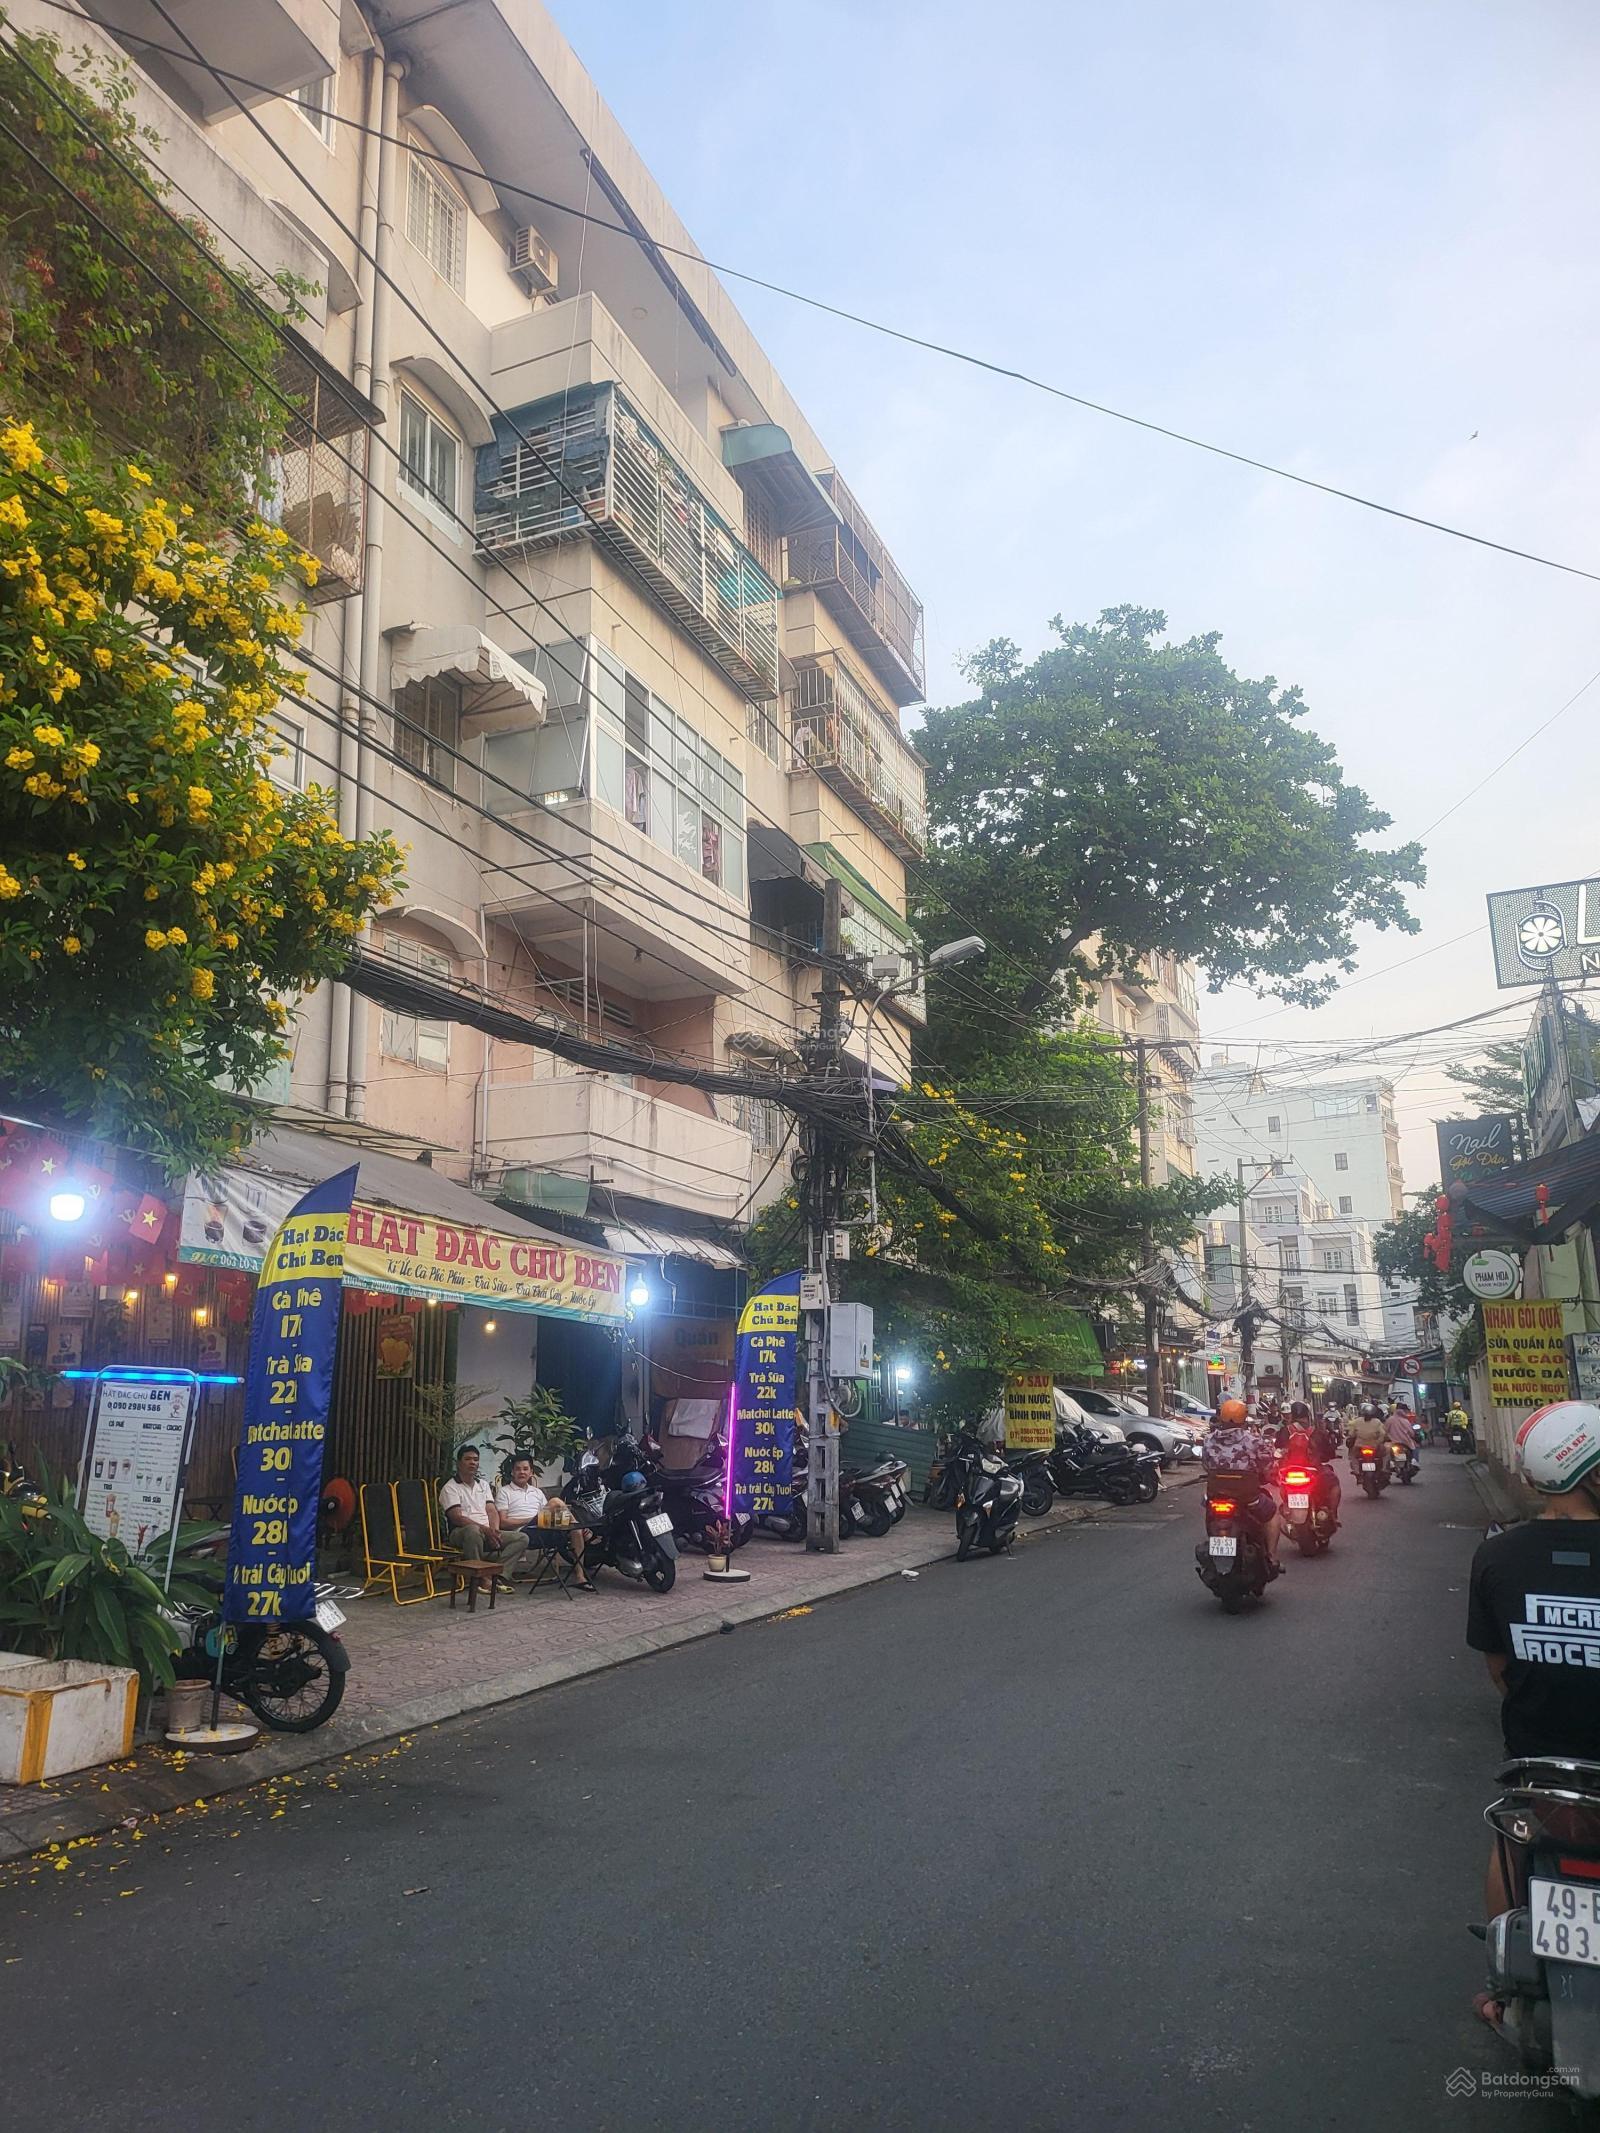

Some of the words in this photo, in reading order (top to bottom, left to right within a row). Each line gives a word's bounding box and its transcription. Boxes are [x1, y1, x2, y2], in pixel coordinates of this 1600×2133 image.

[1450, 1123, 1501, 1155] Nail
[277, 1251, 306, 1270] Chú
[310, 1249, 344, 1267] Ben
[573, 1254, 623, 1294] BEN
[272, 1288, 292, 1310] Cà
[751, 1314, 774, 1325] Chú
[776, 1315, 798, 1325] Ben
[1484, 1304, 1515, 1334] NHẬN
[750, 1335, 764, 1348] Cà
[765, 1335, 786, 1348] Phê
[759, 1349, 777, 1363] 17k
[748, 1371, 766, 1384] Trà
[150, 1389, 171, 1401] BEN
[756, 1385, 777, 1400] 22k
[772, 1407, 794, 1420] Latte
[755, 1421, 775, 1436] 30k
[753, 1460, 775, 1474] 28k
[752, 1496, 775, 1511] 27k
